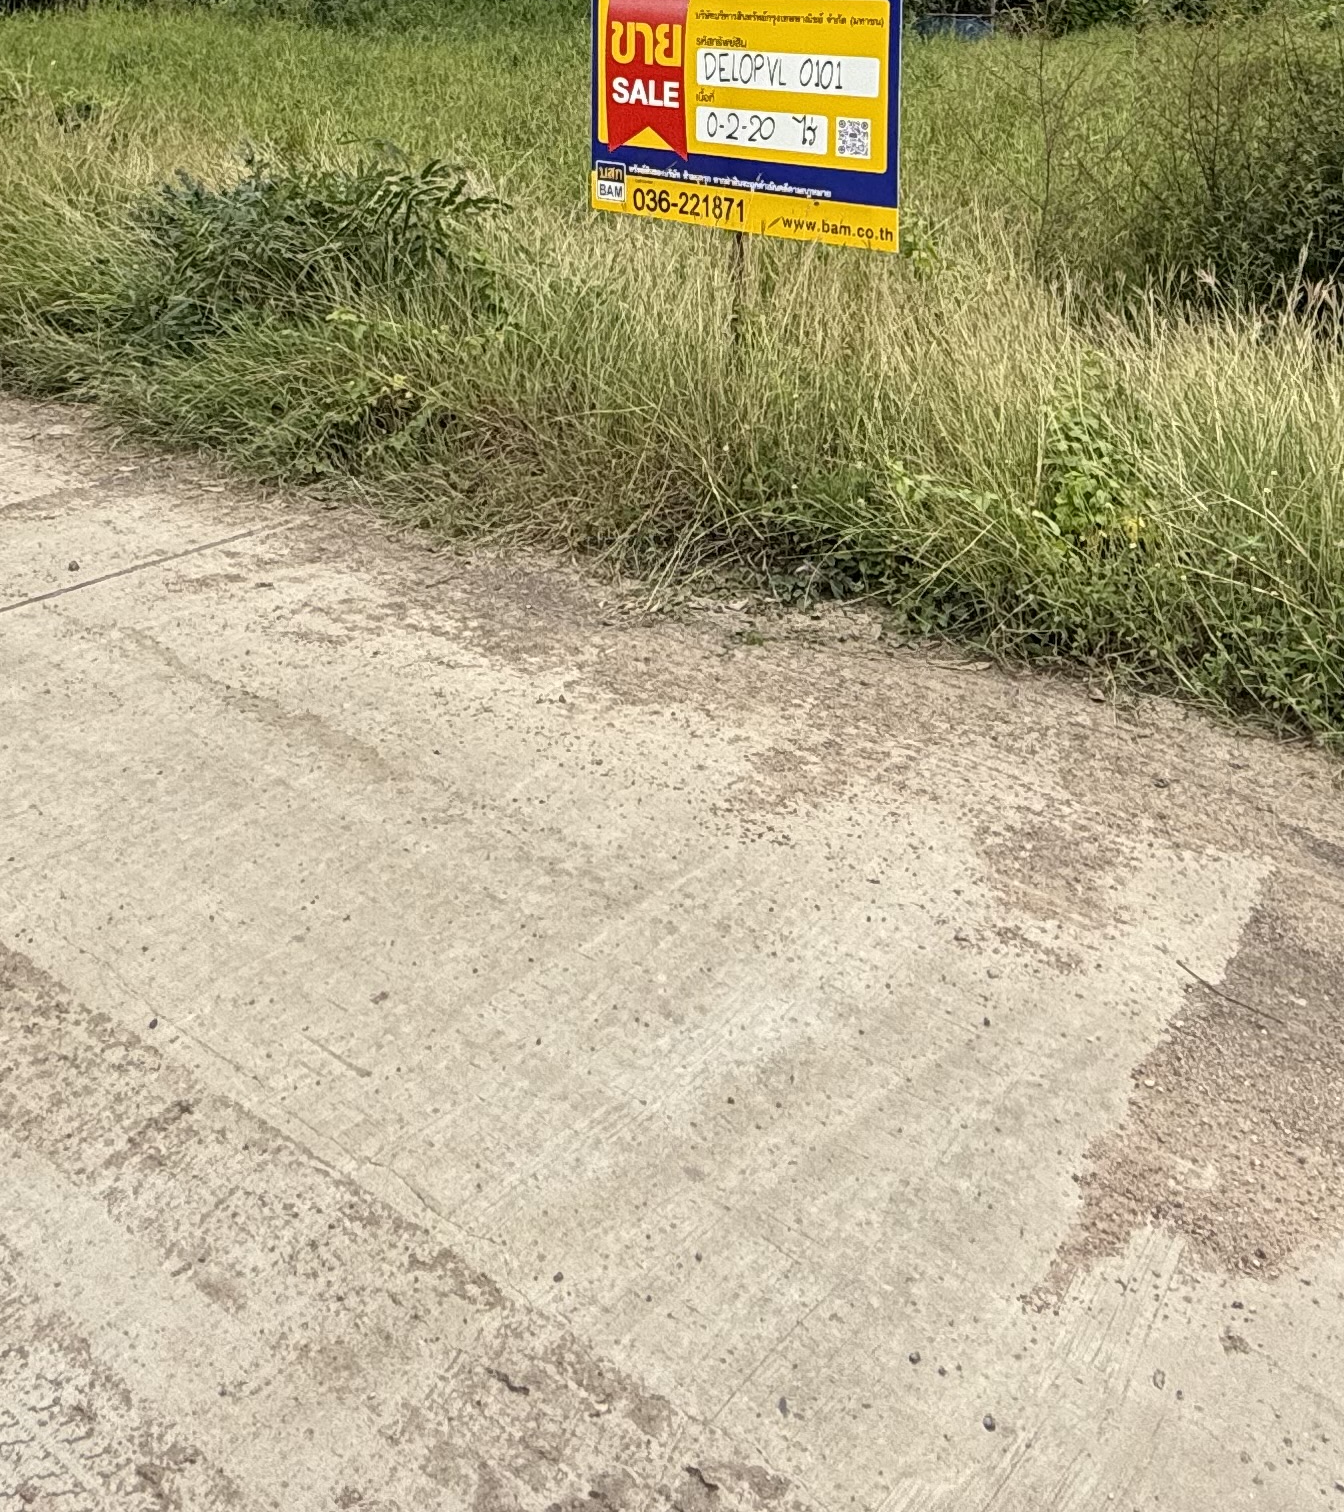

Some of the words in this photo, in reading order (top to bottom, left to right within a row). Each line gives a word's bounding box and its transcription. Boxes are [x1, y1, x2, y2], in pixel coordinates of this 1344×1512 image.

[611, 22, 681, 67] ขาย
[799, 59, 843, 90] 0101
[612, 77, 680, 108] SALE
[706, 111, 776, 142] 0-2-20
[599, 165, 623, 181] บสก
[599, 183, 623, 198] BAM
[633, 187, 745, 223] 036-221871
[782, 217, 894, 242] www.bam.co.th
